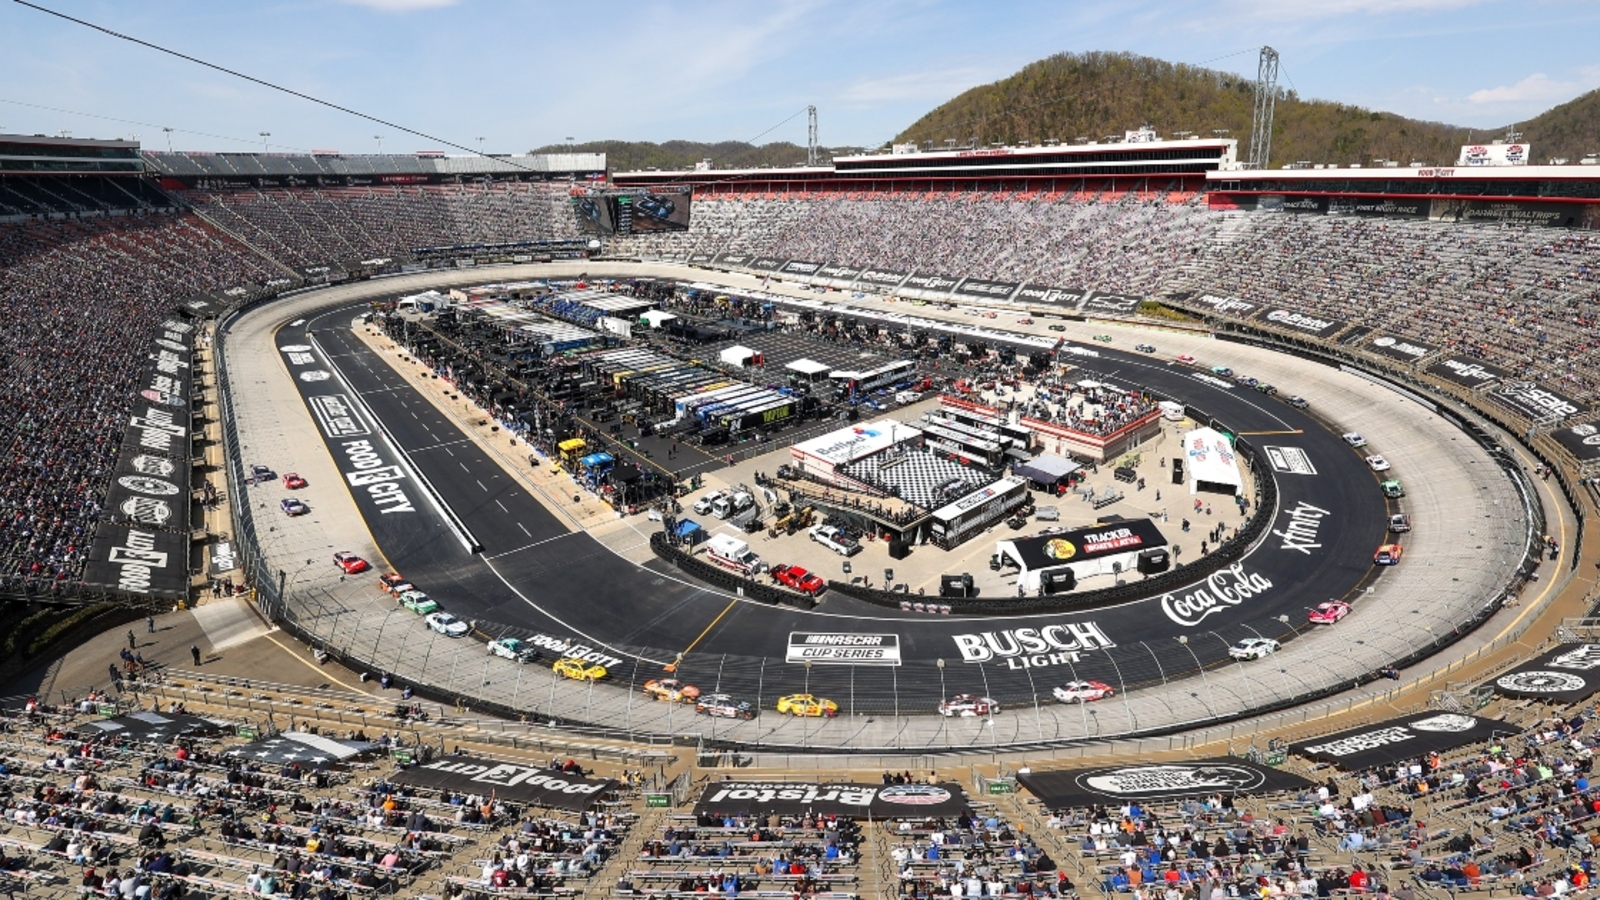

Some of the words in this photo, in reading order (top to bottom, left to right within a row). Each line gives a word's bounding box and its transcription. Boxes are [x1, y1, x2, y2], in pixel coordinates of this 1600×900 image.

[1511, 210, 1561, 220] WALTRIP'S
[1020, 289, 1043, 298] FOOD
[1058, 292, 1081, 302] CITY
[1289, 313, 1334, 329] Bristol
[341, 439, 383, 469] FOOD
[367, 482, 417, 514] CITY
[1084, 528, 1133, 544] TRACKER
[1273, 501, 1331, 555] xfinity
[125, 529, 155, 551] CITY
[118, 563, 151, 594] FOOD
[821, 635, 883, 646] NASCAR
[951, 621, 1117, 663] BUSCH
[526, 633, 570, 652] FOOD
[582, 652, 623, 668] CITY
[802, 648, 833, 657] CUP
[833, 649, 885, 658] SERIES
[1007, 651, 1081, 671] LIGHT
[1327, 731, 1417, 757] TRACKER
[419, 760, 488, 775] CITY
[525, 775, 606, 794] FOOD
[725, 782, 811, 791] Speedway
[823, 784, 879, 795] Motor
[709, 789, 875, 806] Bristol
